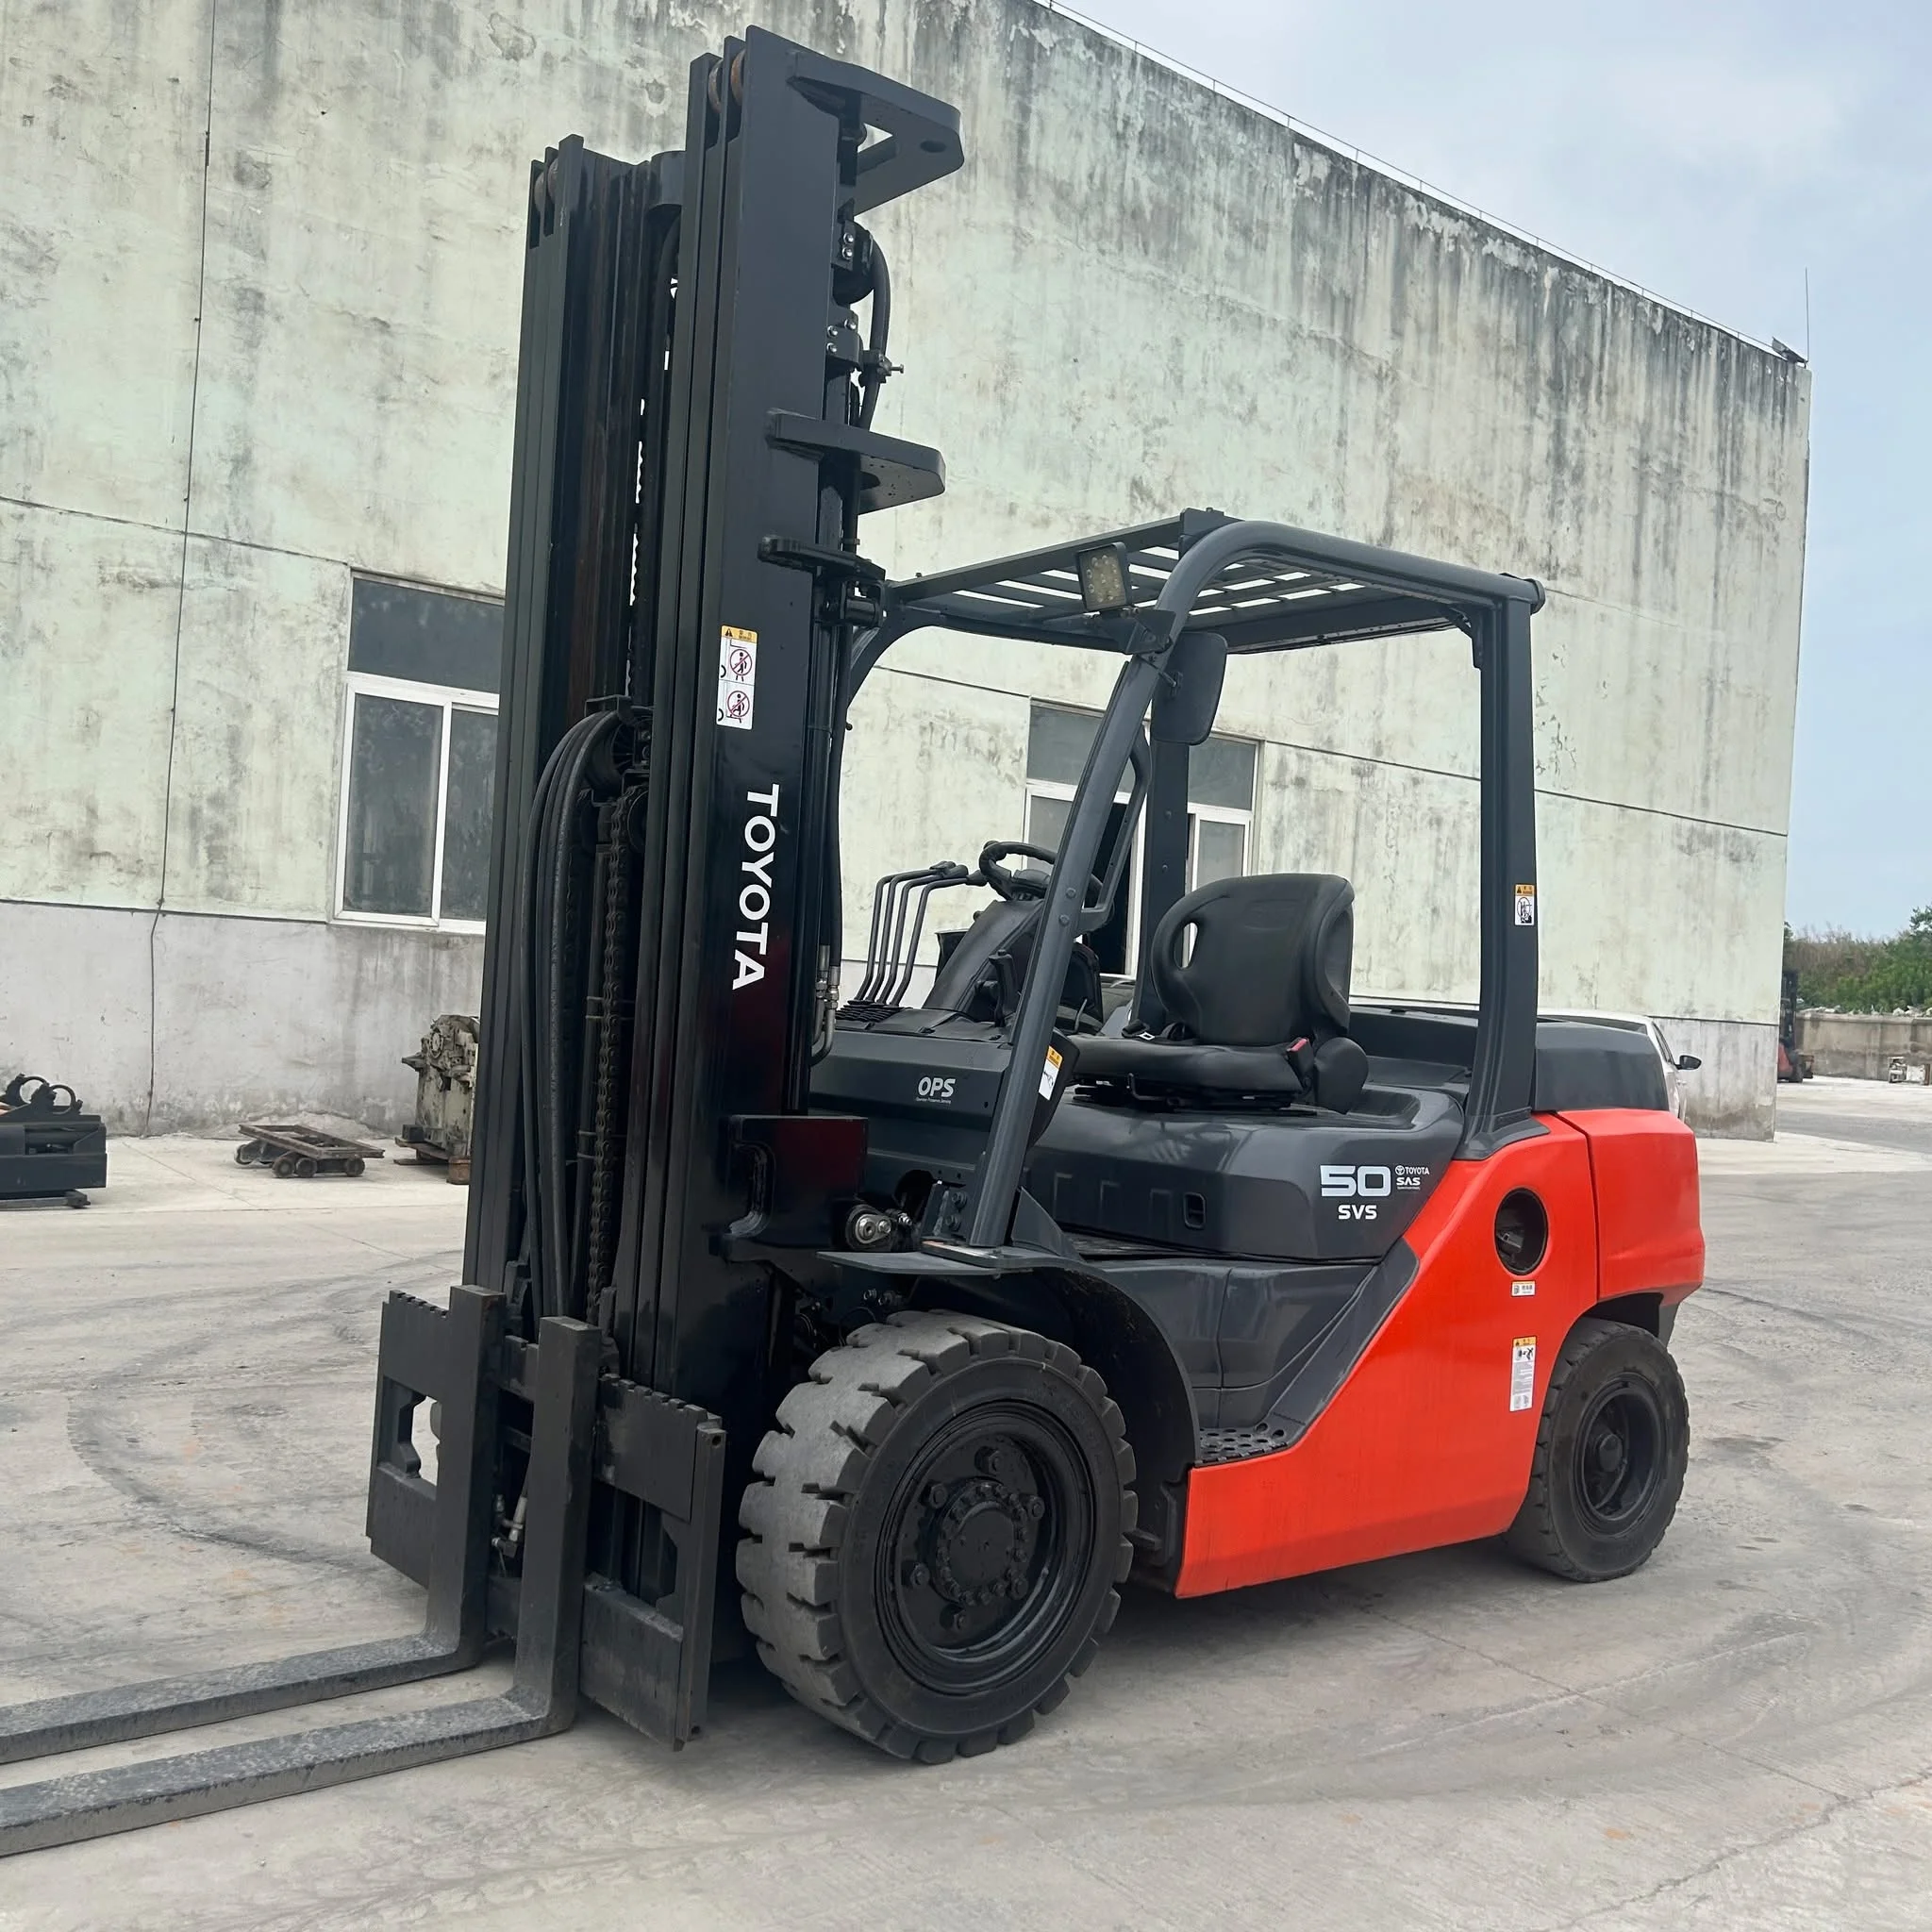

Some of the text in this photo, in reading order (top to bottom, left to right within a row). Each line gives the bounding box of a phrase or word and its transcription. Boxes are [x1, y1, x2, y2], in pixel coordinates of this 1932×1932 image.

[732, 783, 780, 991] TOYOTA
[918, 1076, 956, 1097] OPS
[1405, 1166, 1430, 1175] TOYOTA
[1320, 1165, 1391, 1196] 50
[1396, 1176, 1421, 1186] SAS
[1338, 1205, 1377, 1220] SVS
